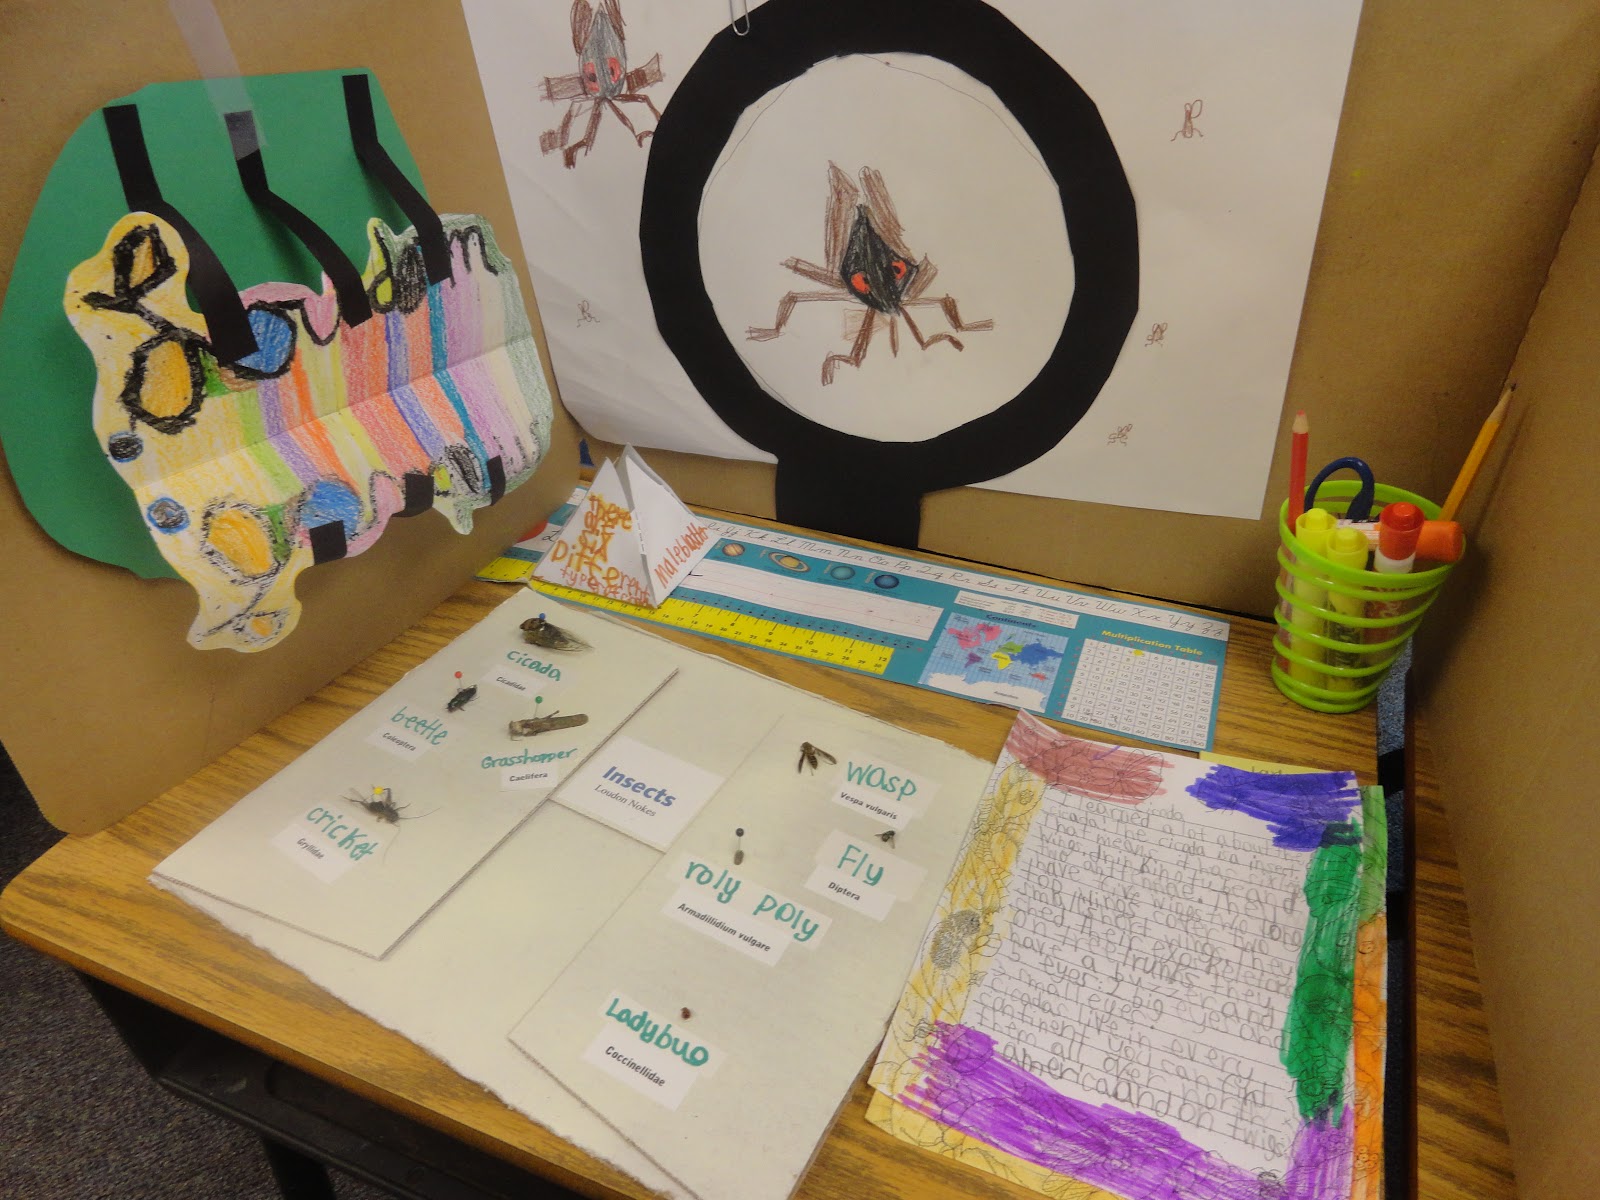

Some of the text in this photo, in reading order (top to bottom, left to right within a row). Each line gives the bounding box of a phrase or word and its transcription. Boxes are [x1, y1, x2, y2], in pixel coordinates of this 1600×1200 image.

[1101, 629, 1204, 657] Multiplication Table
[391, 706, 449, 746] beetle
[481, 748, 578, 769] Grasshopper
[509, 771, 548, 782] Caelifera
[602, 766, 677, 807] Insects
[594, 784, 657, 817] Loudon Nokes
[840, 792, 898, 820] Vespa vulgaris
[1077, 796, 1151, 829] learned
[1215, 827, 1270, 859] about
[297, 838, 325, 859] Gryllidae
[1157, 832, 1207, 859] cicada
[685, 861, 741, 904] roly
[837, 844, 884, 886] Fly
[828, 882, 861, 901] Diptera
[677, 903, 771, 952] Armadillidium vulgare
[1003, 923, 1064, 961] have
[605, 1046, 666, 1087] Coccinellidae
